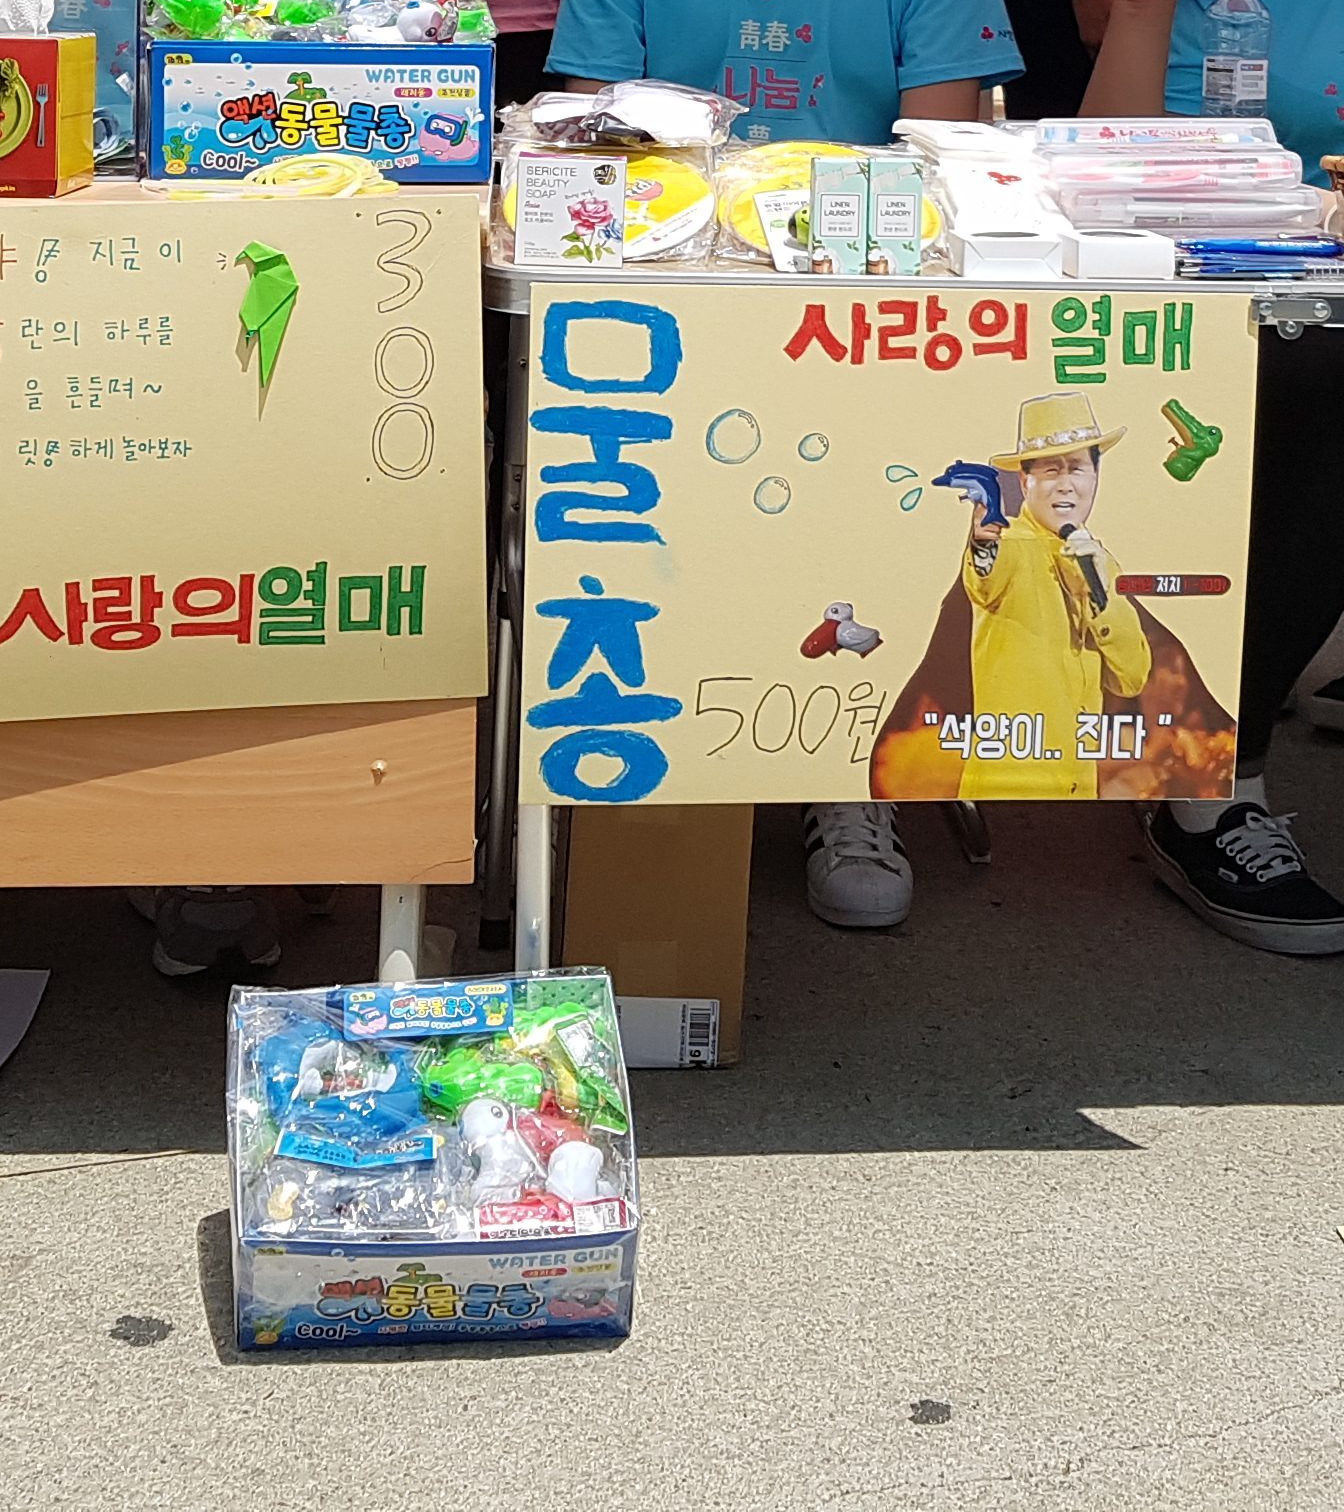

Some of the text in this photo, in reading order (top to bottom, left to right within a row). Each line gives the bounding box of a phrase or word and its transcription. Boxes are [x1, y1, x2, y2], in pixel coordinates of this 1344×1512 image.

[365, 68, 476, 84] WATER GUN
[723, 65, 801, 111] 나눔
[275, 101, 344, 149] 동물
[526, 165, 578, 177] SERICITE
[526, 178, 570, 188] BEAUTY
[526, 189, 557, 199] SOAP
[89, 237, 141, 271] 지금
[159, 239, 181, 263] 이
[104, 316, 174, 346] 하루를
[783, 294, 1194, 385] 사랑의 열매
[69, 437, 114, 459] 하게
[122, 435, 193, 461] 놀아보자
[527, 300, 684, 804] 물총
[256, 560, 427, 647] 열매
[695, 675, 888, 765] 500원
[489, 1247, 620, 1271] WATER GUN
